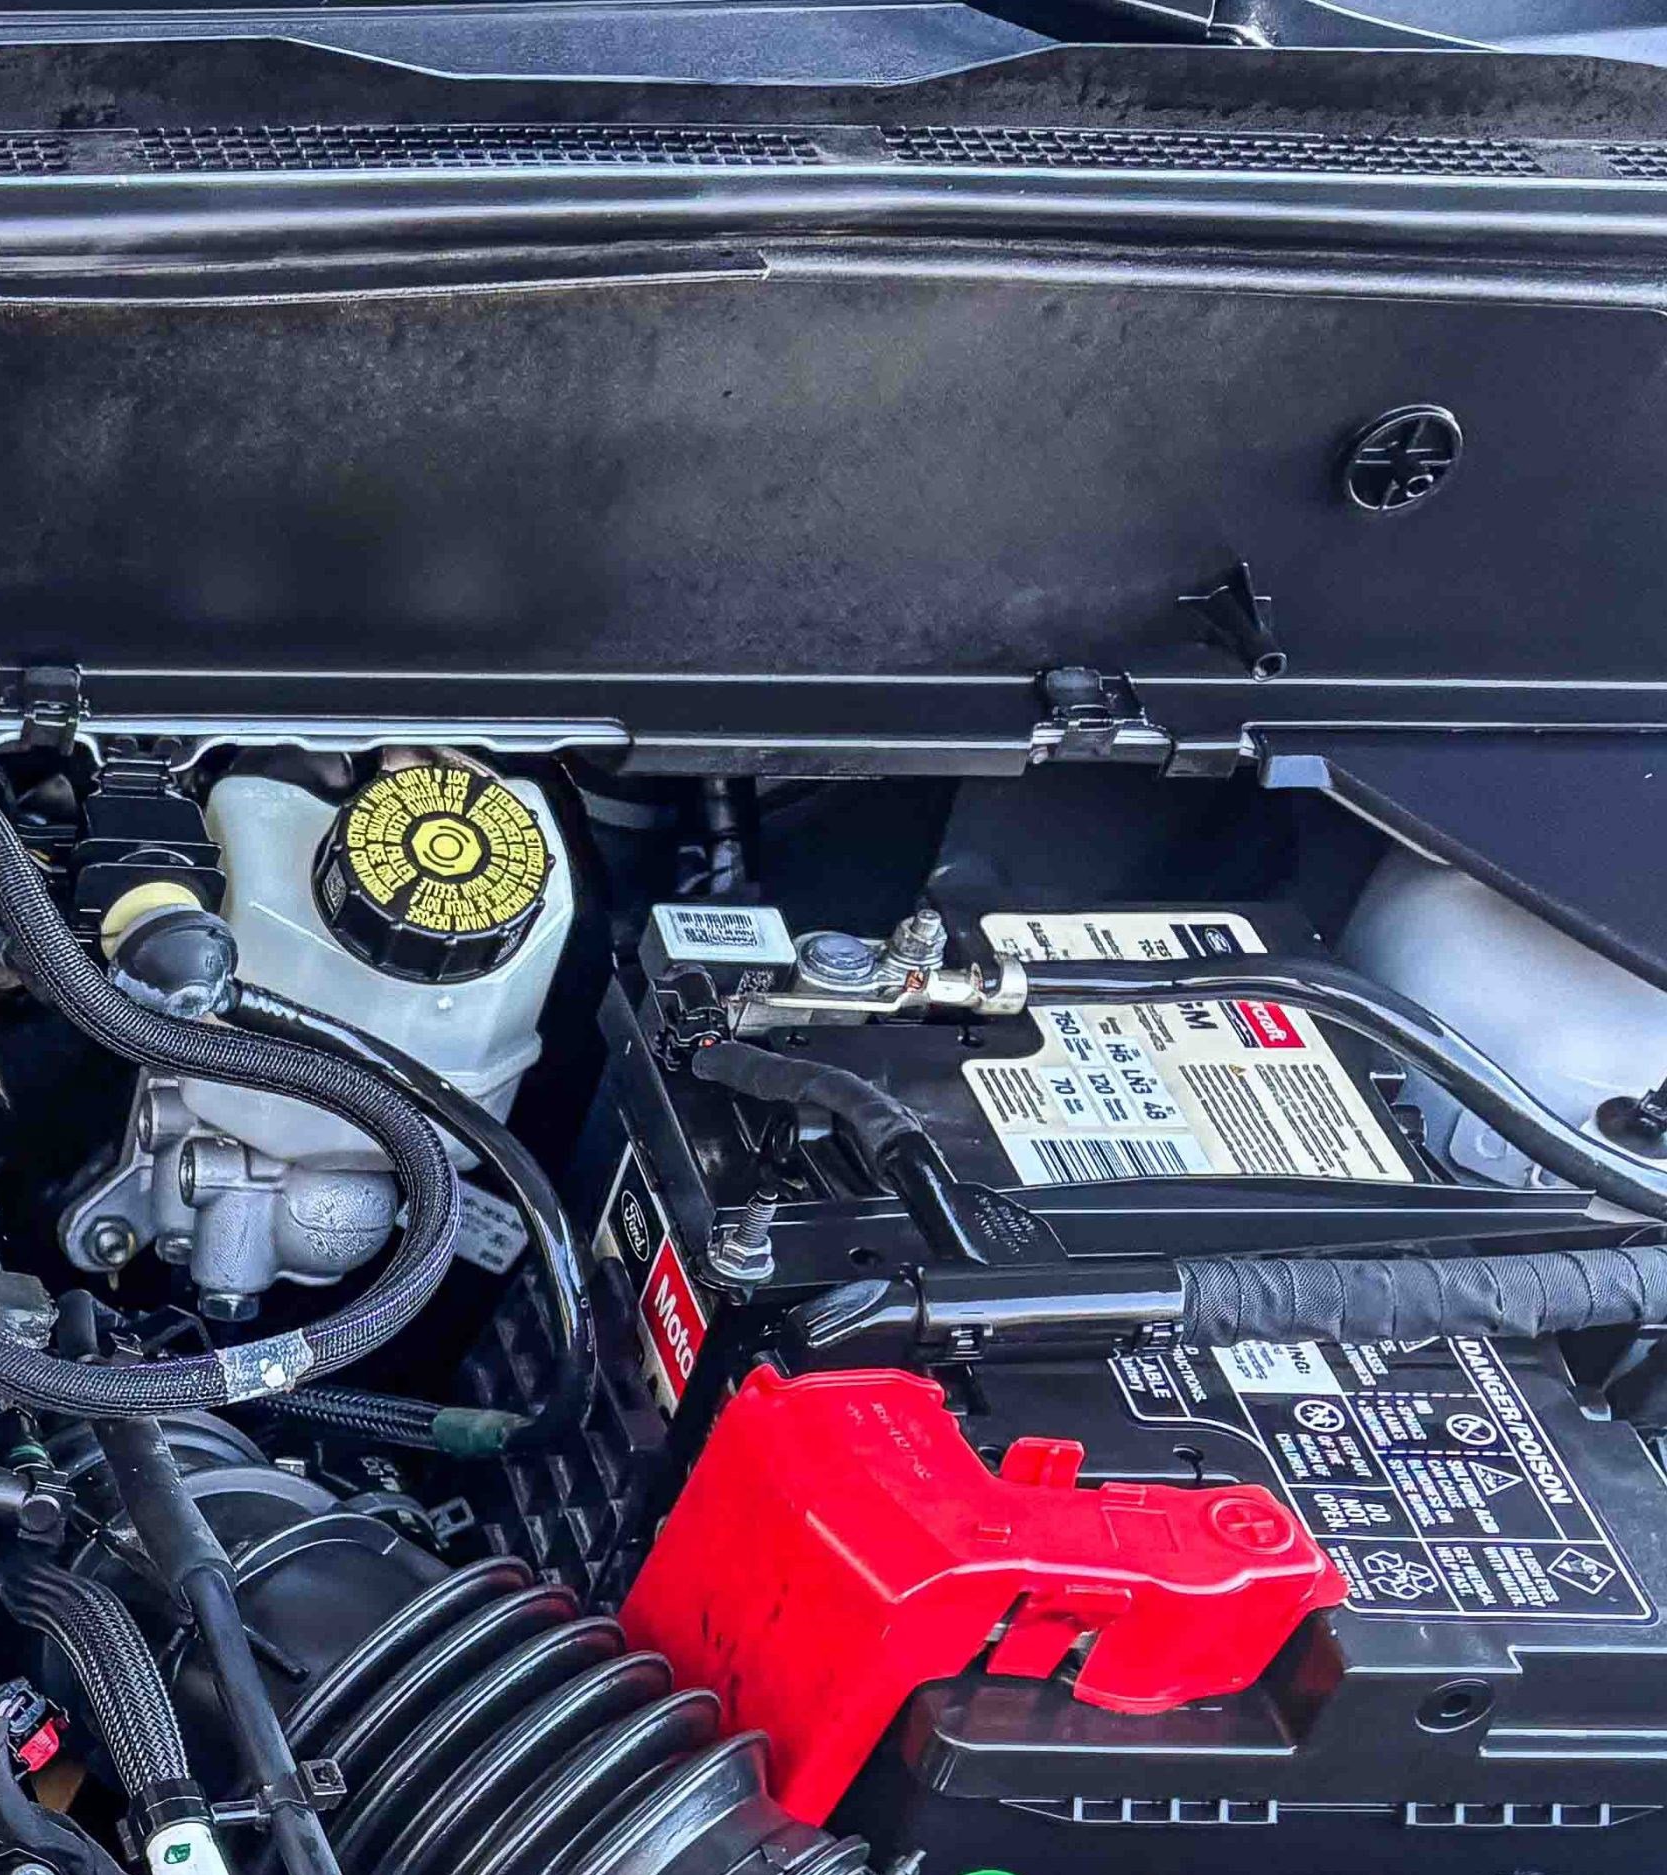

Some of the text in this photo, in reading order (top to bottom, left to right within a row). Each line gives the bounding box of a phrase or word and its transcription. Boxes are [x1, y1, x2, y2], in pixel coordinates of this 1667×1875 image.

[364, 776, 399, 805] FROM
[393, 767, 431, 788] FLUID
[394, 781, 440, 803] BEFORE
[443, 783, 468, 801] CAP
[445, 769, 471, 787] DOT
[406, 797, 466, 818] WARNING
[346, 808, 371, 848] SEALED
[383, 809, 413, 844] CLEAN
[520, 873, 543, 890] LE
[402, 904, 450, 930] DEPOSE
[418, 894, 442, 913] DOT
[472, 893, 493, 912] DE
[487, 885, 535, 924] BOUCHON
[453, 910, 493, 931] AVANT
[1048, 1009, 1081, 1034] 760
[1048, 1077, 1076, 1094] 70
[1086, 1073, 1116, 1094] 120
[1104, 1043, 1134, 1062] H6
[1120, 1069, 1153, 1093] LN3
[1140, 1101, 1169, 1119] 48
[623, 1202, 646, 1251] Ford
[1456, 1341, 1573, 1504] DANGER/POISON
[1294, 1434, 1332, 1476] REACH OF
[1315, 1435, 1346, 1465] OF THE
[1336, 1435, 1372, 1477] KEEP OUT
[1385, 1459, 1418, 1493] SEVERE
[1405, 1459, 1455, 1523] BLINDNESS OR
[1424, 1460, 1466, 1508] CAN CAUSE
[1309, 1493, 1351, 1531] OPEN.
[1337, 1498, 1371, 1526] NOT
[1362, 1504, 1392, 1522] DO
[1444, 1460, 1501, 1533] SULFURIC ACID
[1433, 1546, 1476, 1596] HELP FAST.
[1450, 1546, 1498, 1605] GET MEDICAL
[1480, 1547, 1529, 1606] WITH WATER.
[1497, 1547, 1546, 1606] IMMEDIATELY
[1514, 1547, 1560, 1602] FLUSH EYES
